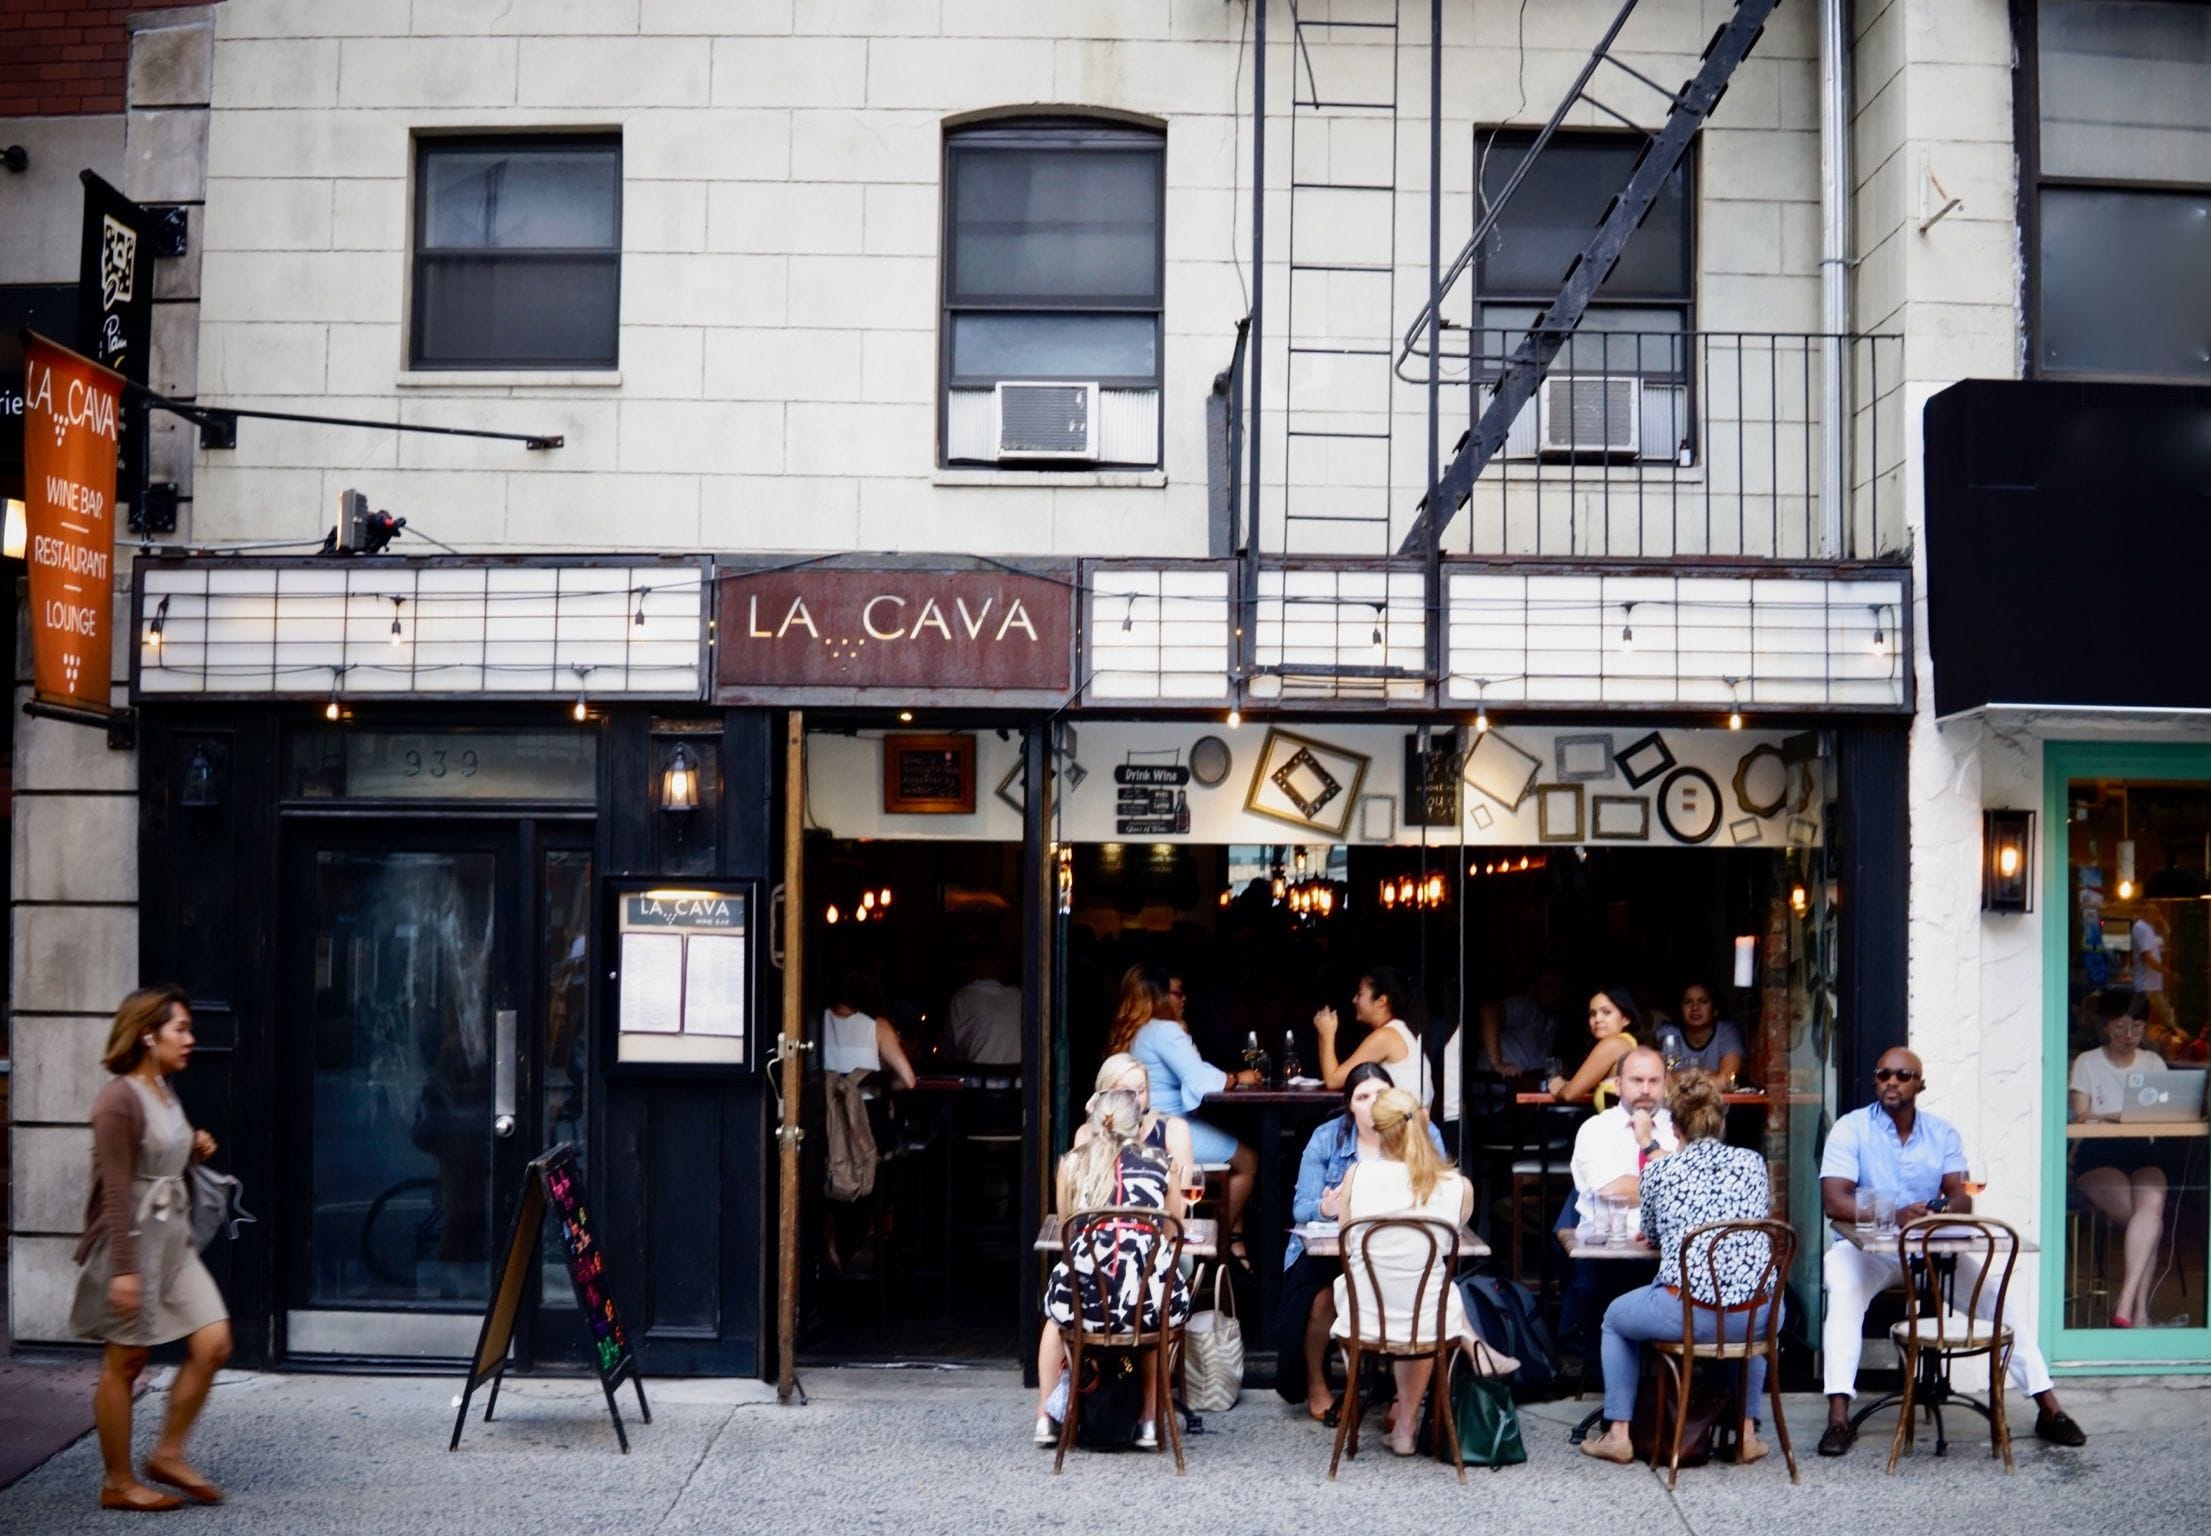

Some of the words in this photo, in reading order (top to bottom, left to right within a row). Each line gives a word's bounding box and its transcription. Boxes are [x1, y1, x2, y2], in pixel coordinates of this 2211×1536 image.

[26, 360, 53, 415] LA
[68, 378, 117, 442] CAVA
[46, 474, 79, 512] WINE
[80, 486, 103, 521] BAR
[34, 534, 108, 580] RESTAURANT
[46, 599, 96, 638] LOUNGE
[749, 594, 819, 638] LA
[863, 595, 1039, 641] CAVA
[404, 749, 479, 779] 939
[1125, 768, 1151, 781] Drink
[1153, 769, 1177, 782] Wine
[641, 899, 664, 915] LA
[676, 899, 730, 916] CAVA
